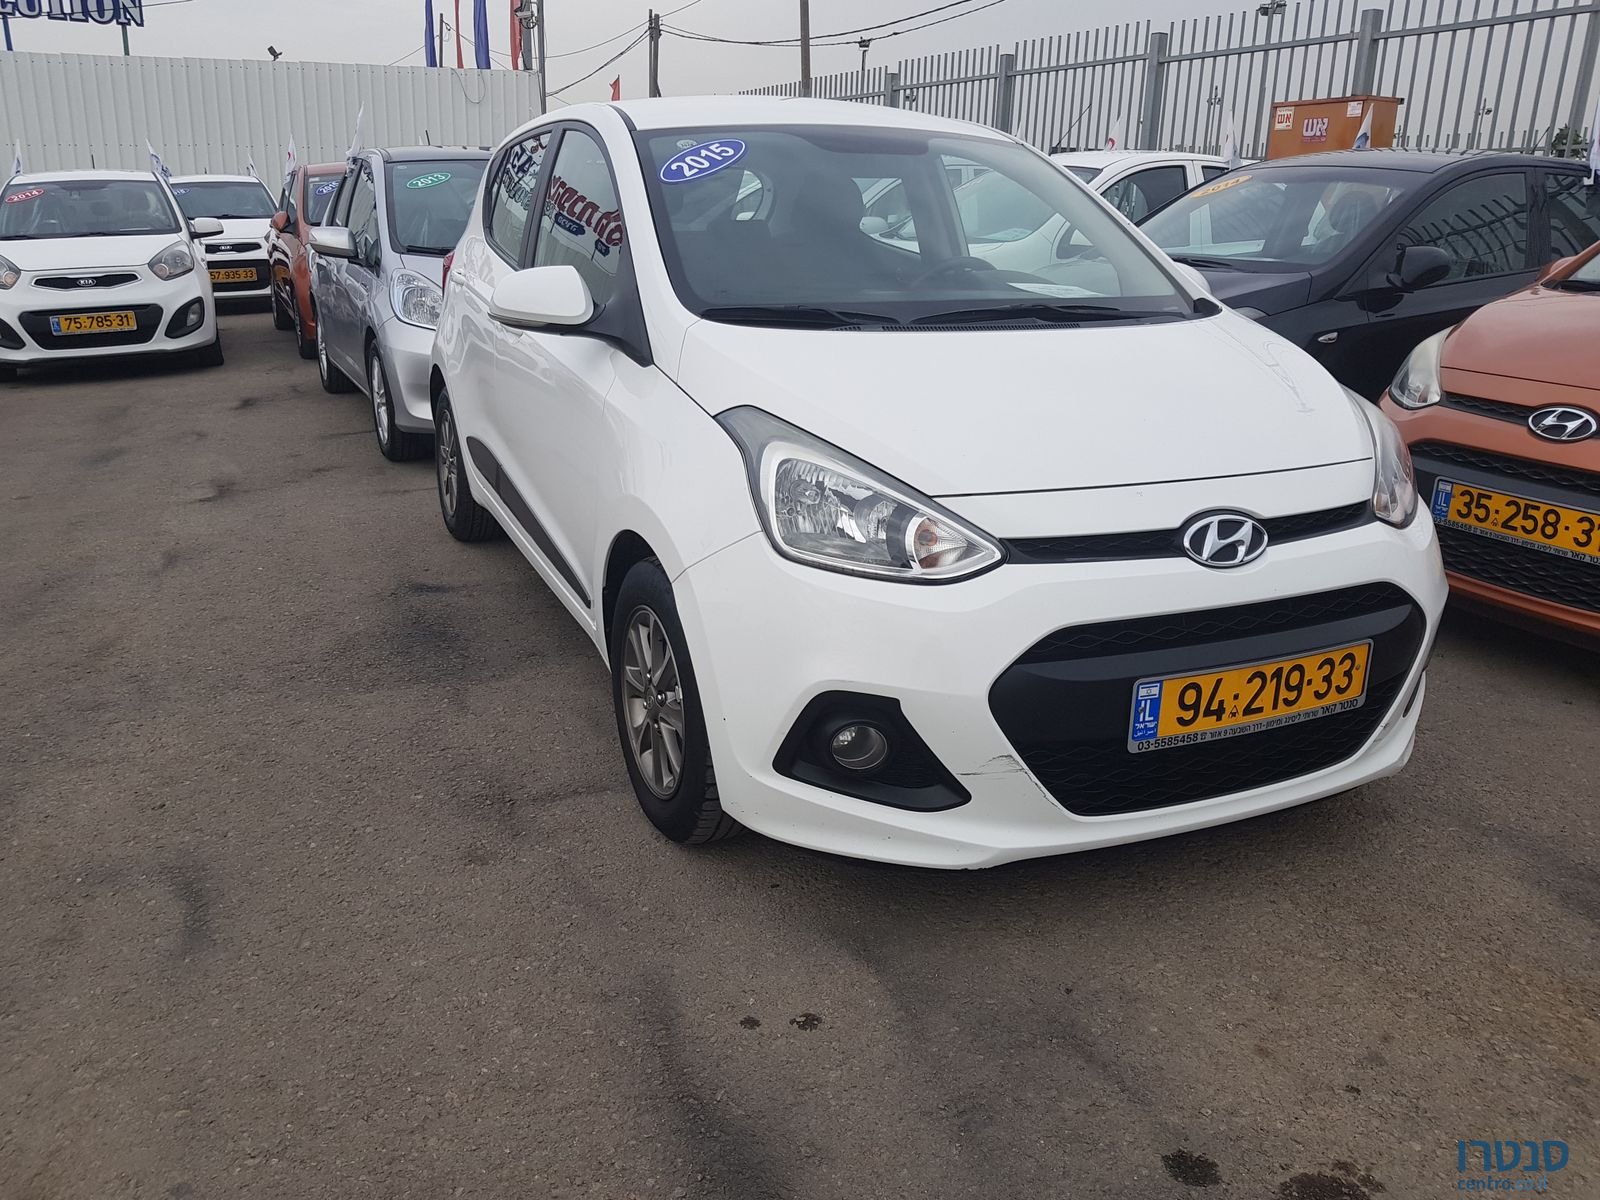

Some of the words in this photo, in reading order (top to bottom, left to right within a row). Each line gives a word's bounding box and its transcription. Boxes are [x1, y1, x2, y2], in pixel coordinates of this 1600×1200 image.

[1278, 113, 1291, 124] אש
[1303, 117, 1329, 137] אש
[671, 143, 734, 177] 2015
[412, 173, 446, 187] 2013
[12, 190, 39, 201] 2014
[1140, 699, 1154, 721] IL
[1320, 703, 1337, 716] קאר
[1339, 699, 1358, 711] סנטר
[1135, 721, 1158, 730] ישראל
[1137, 733, 1198, 751] 03-5585458
